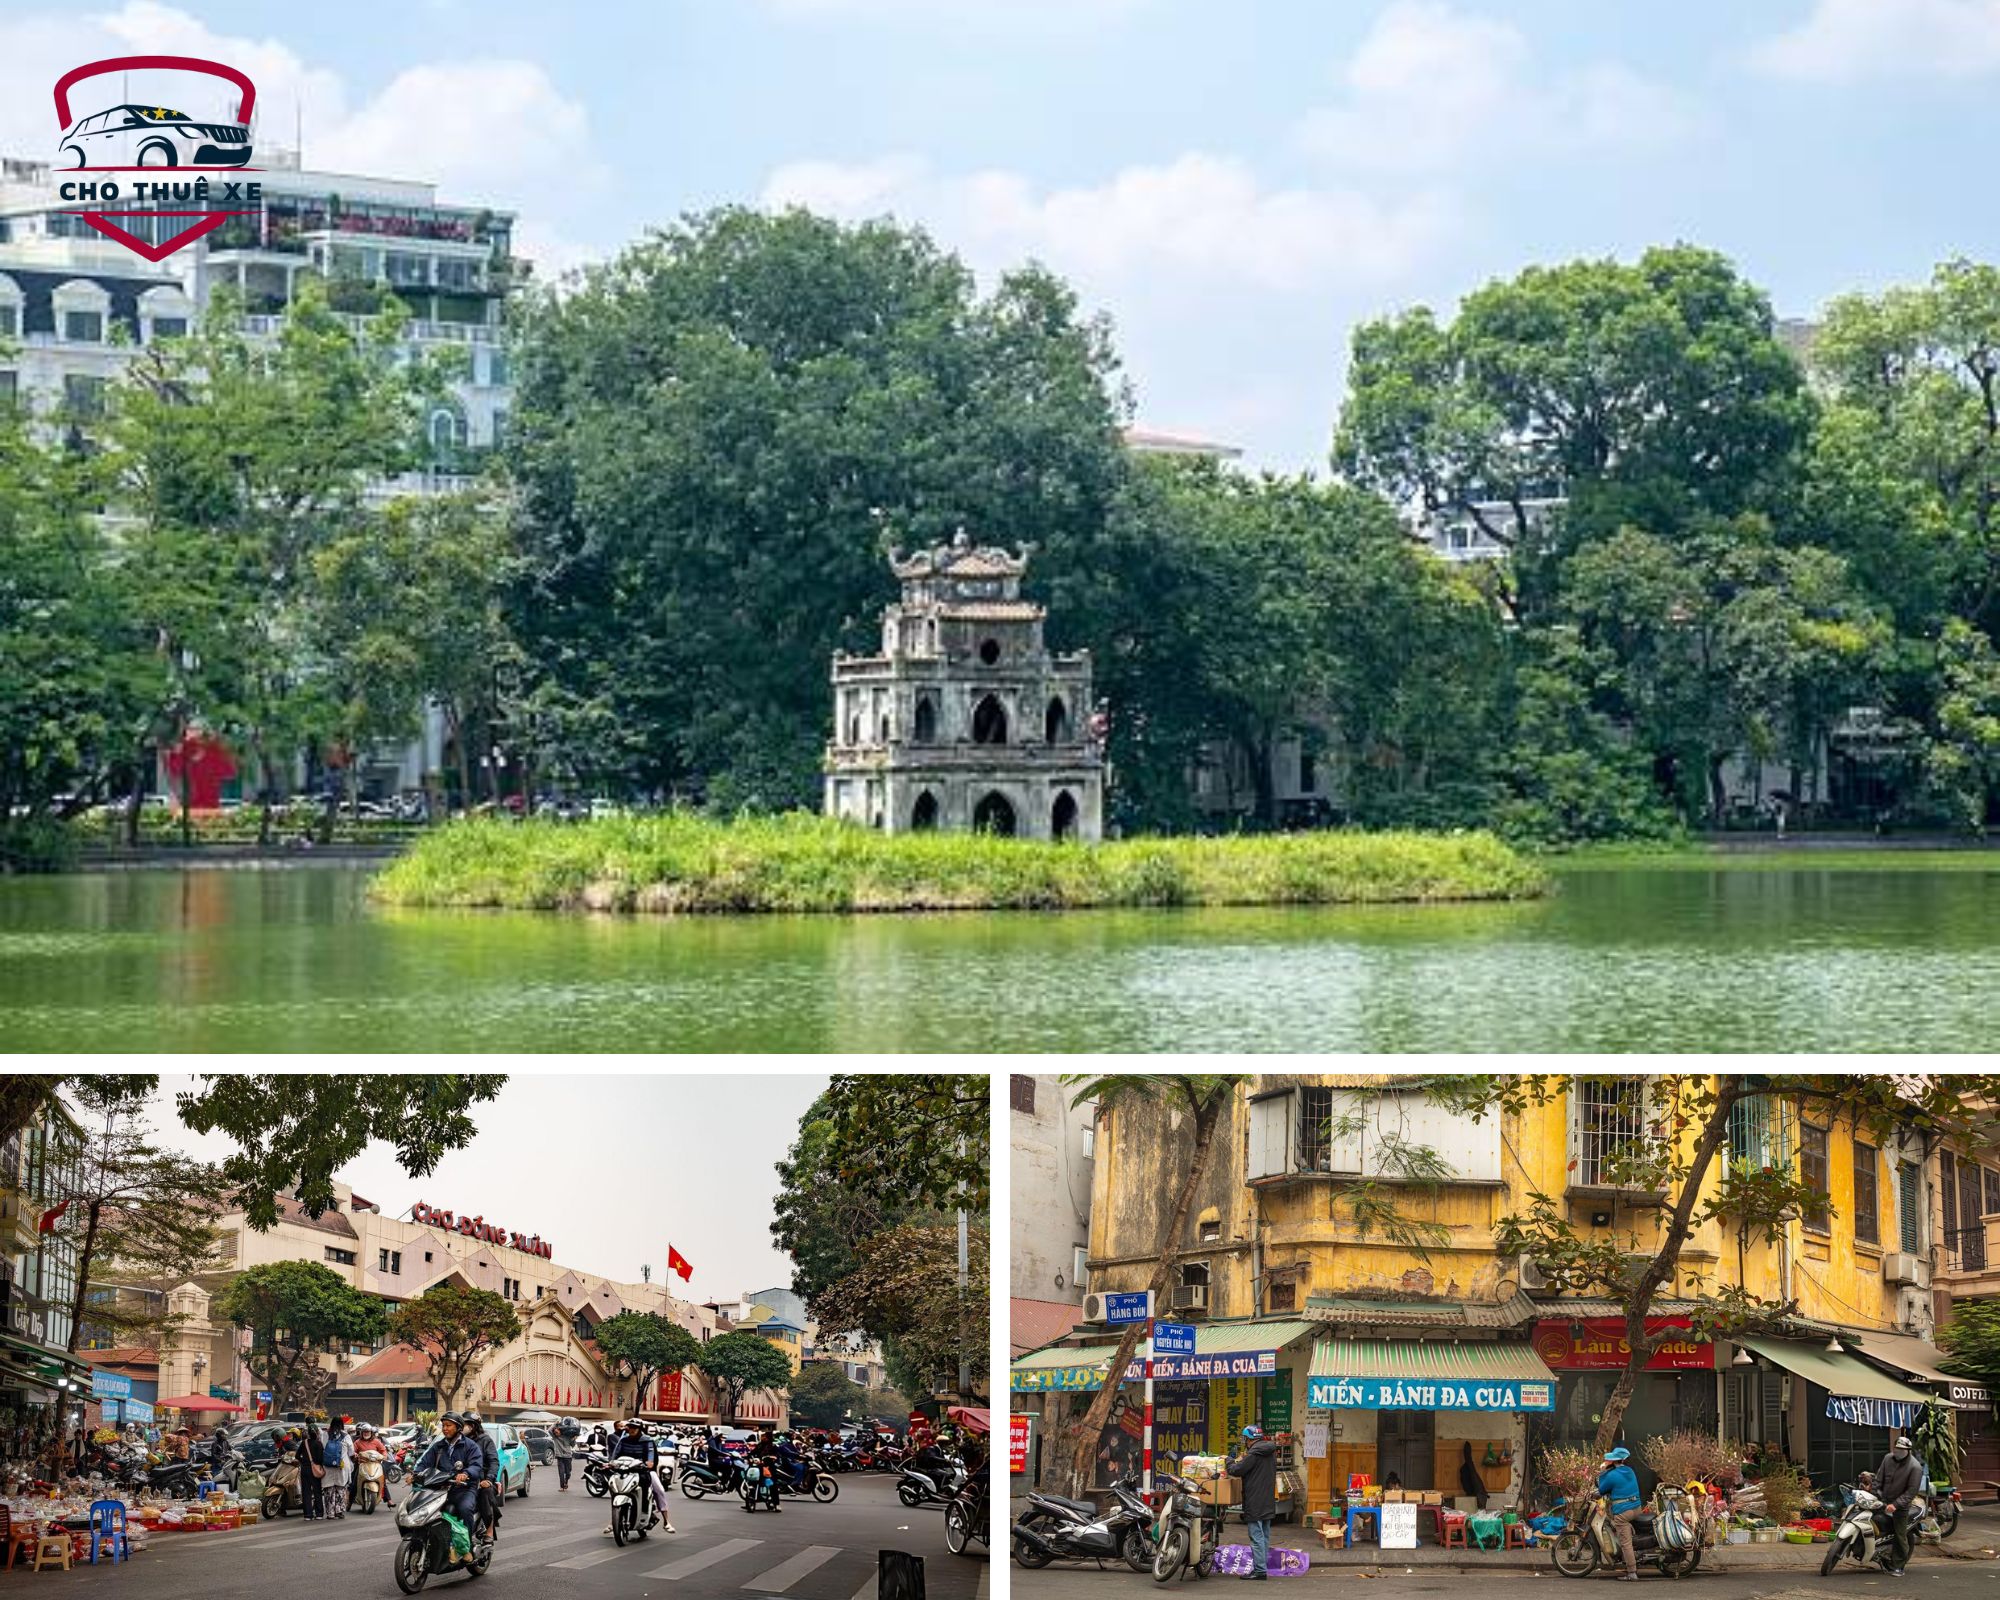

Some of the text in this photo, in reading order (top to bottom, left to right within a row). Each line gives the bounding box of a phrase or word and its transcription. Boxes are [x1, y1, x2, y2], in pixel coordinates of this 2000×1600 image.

[1110, 1304, 1146, 1319] HÀNG BÚN
[1181, 1358, 1212, 1376] BÁNH
[1213, 1361, 1230, 1374] ĐA
[1232, 1358, 1257, 1374] CUA
[1312, 1377, 1363, 1405] MIẾN
[1379, 1381, 1435, 1406] BÁNH
[1440, 1386, 1470, 1407] ĐA
[1475, 1387, 1516, 1408] CUA
[1157, 1427, 1203, 1452] BÁN SẴN
